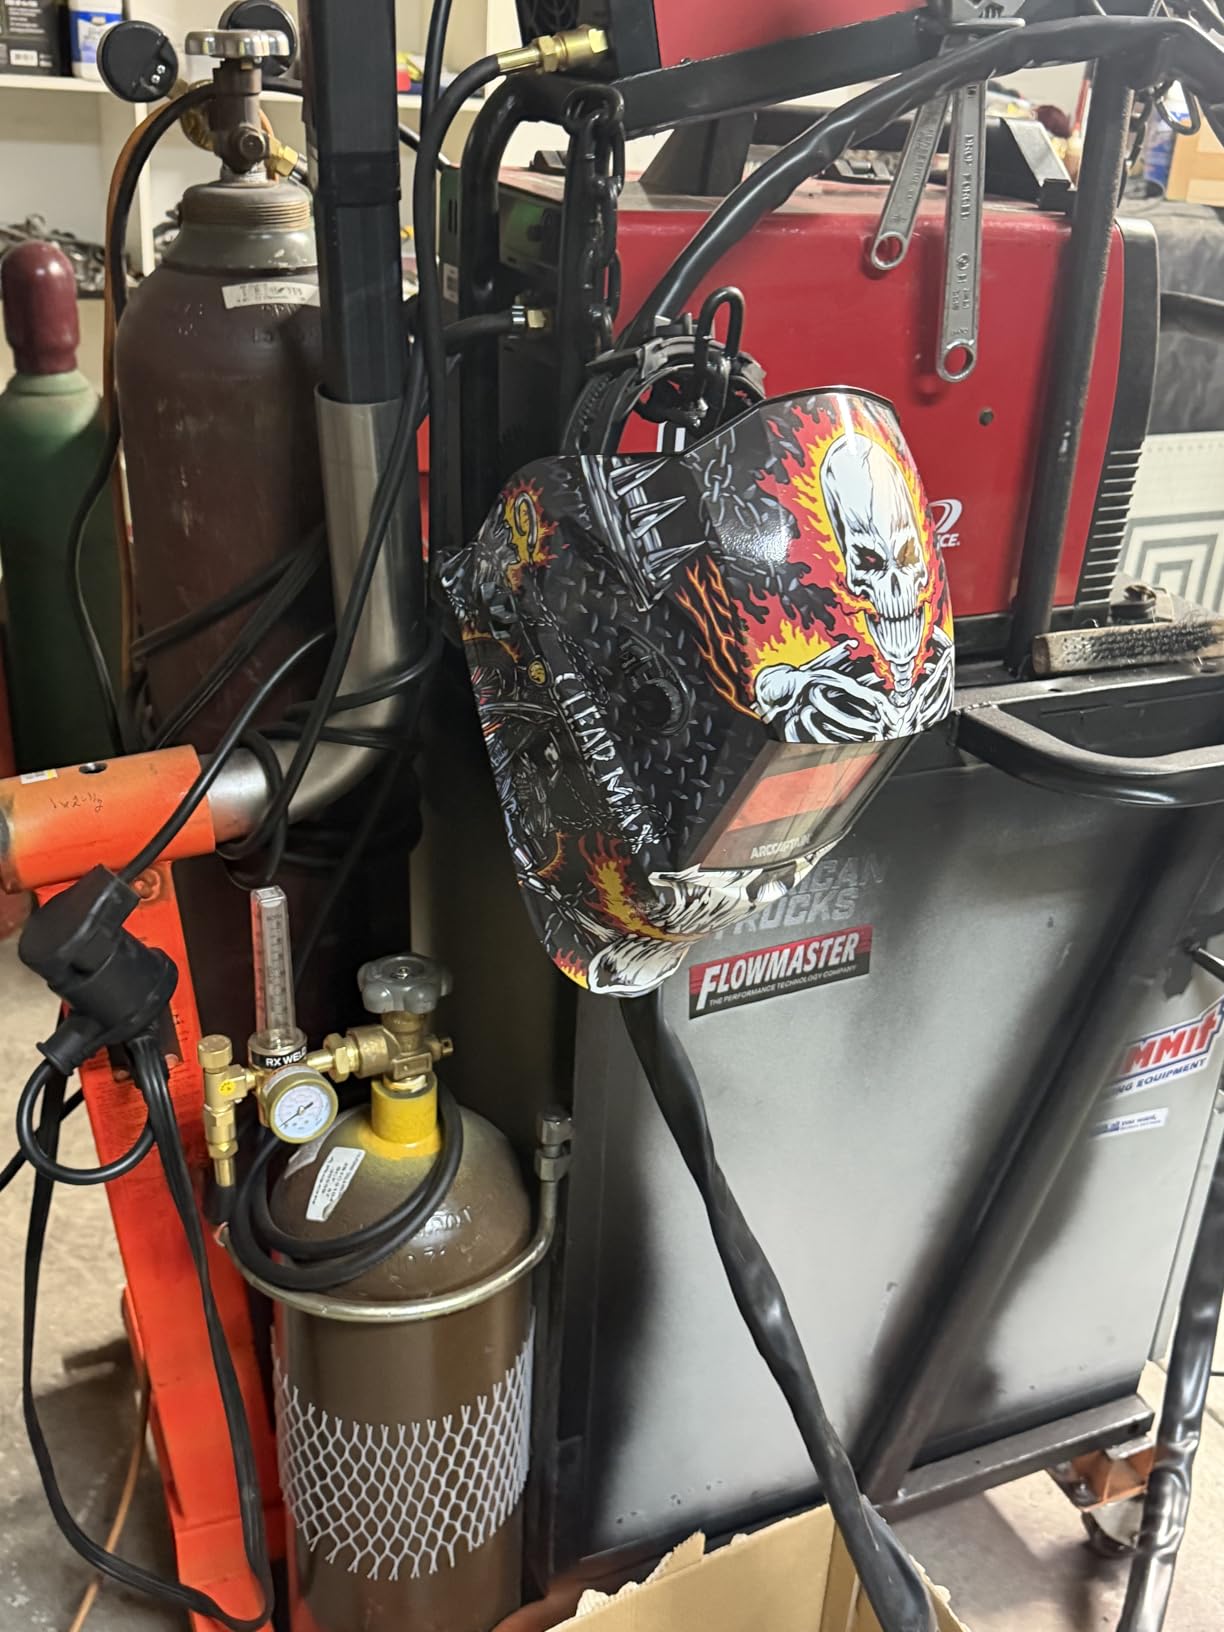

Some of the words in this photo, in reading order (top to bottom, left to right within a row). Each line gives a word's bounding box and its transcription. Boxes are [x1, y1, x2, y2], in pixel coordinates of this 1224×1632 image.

[714, 886, 860, 941] UCKS
[695, 932, 860, 1011] FLOWMASTER
[709, 996, 722, 1007] THE
[723, 982, 777, 1003] PERFORMANCE
[776, 972, 822, 989] TECHNOLOGY
[822, 964, 857, 979] COMPANY
[265, 1057, 282, 1067] RX
[1136, 1057, 1207, 1088] EQUIPMENT
